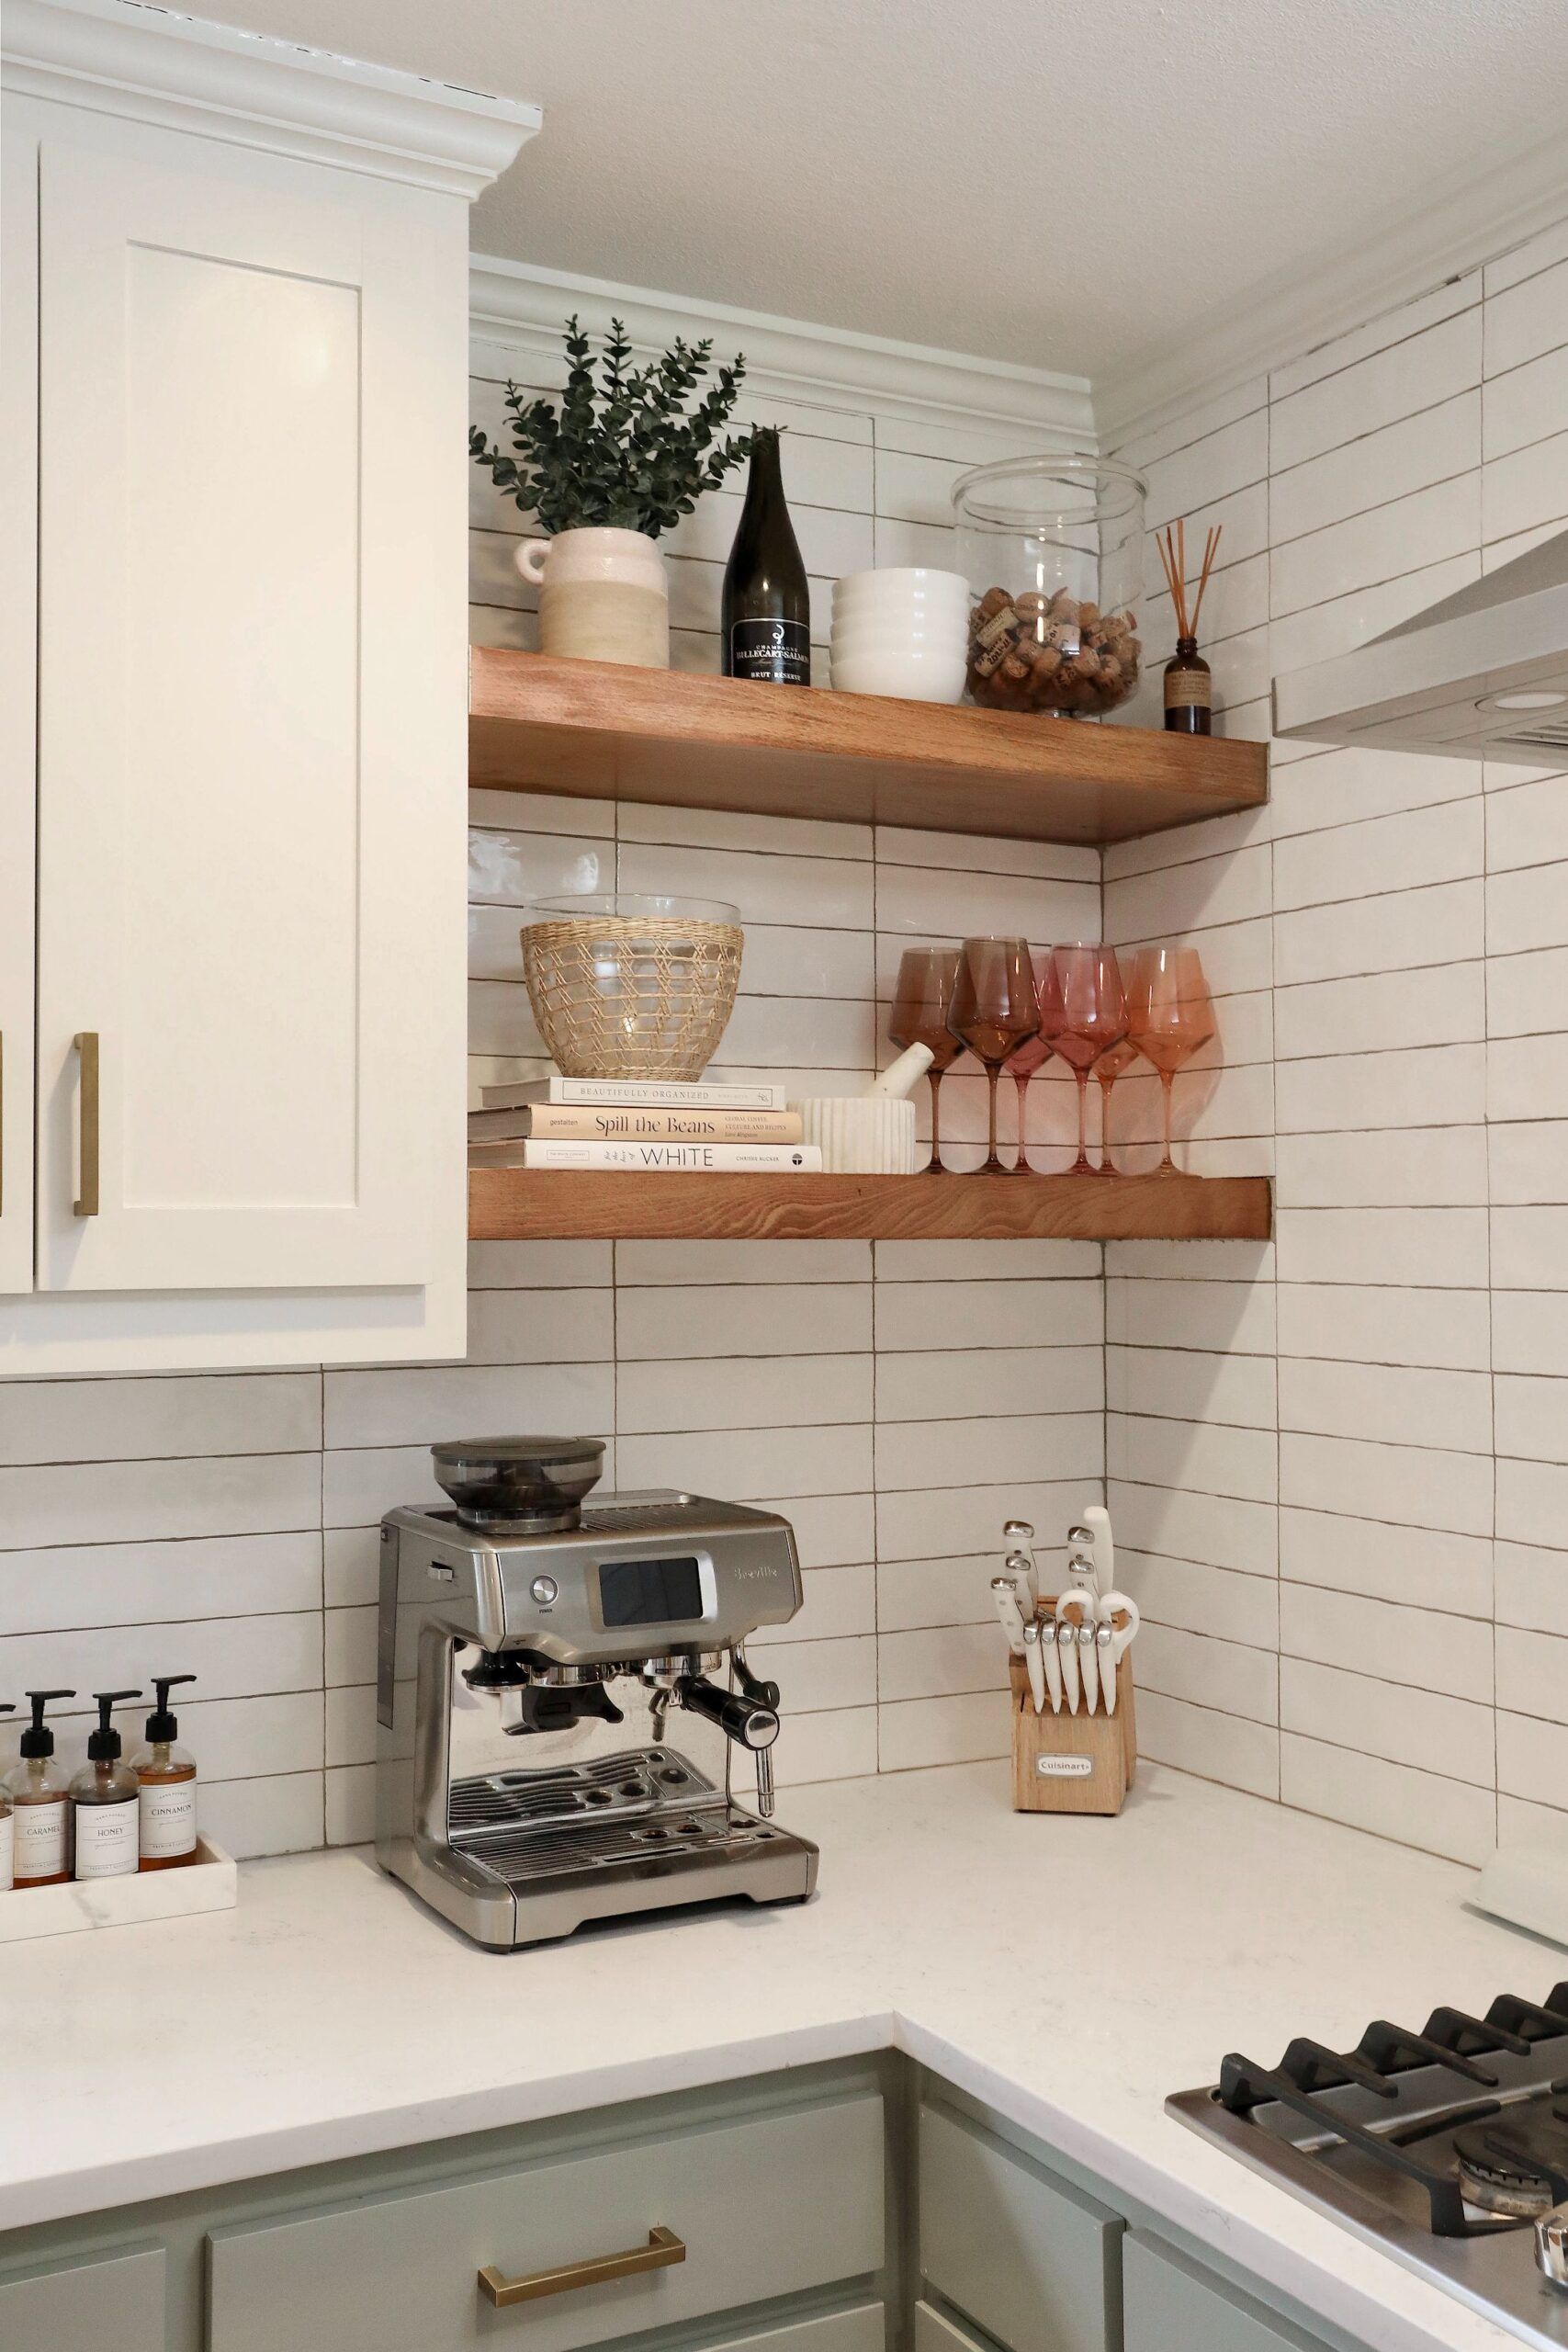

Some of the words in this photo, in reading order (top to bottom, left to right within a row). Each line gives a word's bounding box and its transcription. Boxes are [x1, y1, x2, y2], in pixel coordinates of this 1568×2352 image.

[756, 644, 798, 652] CHAMPAGNE
[580, 1087, 649, 1098] BEAUTIFULLY
[652, 1089, 710, 1100] ORGANIZED
[549, 1118, 579, 1127] gestalten
[595, 1114, 628, 1136] Spill
[636, 1116, 661, 1133] the
[667, 1117, 716, 1134] Beans
[640, 1148, 714, 1167] WHITE
[1041, 1761, 1086, 1770] Cuisinart
[151, 1803, 192, 1816] CINNAMON
[97, 1827, 124, 1837] HONEY
